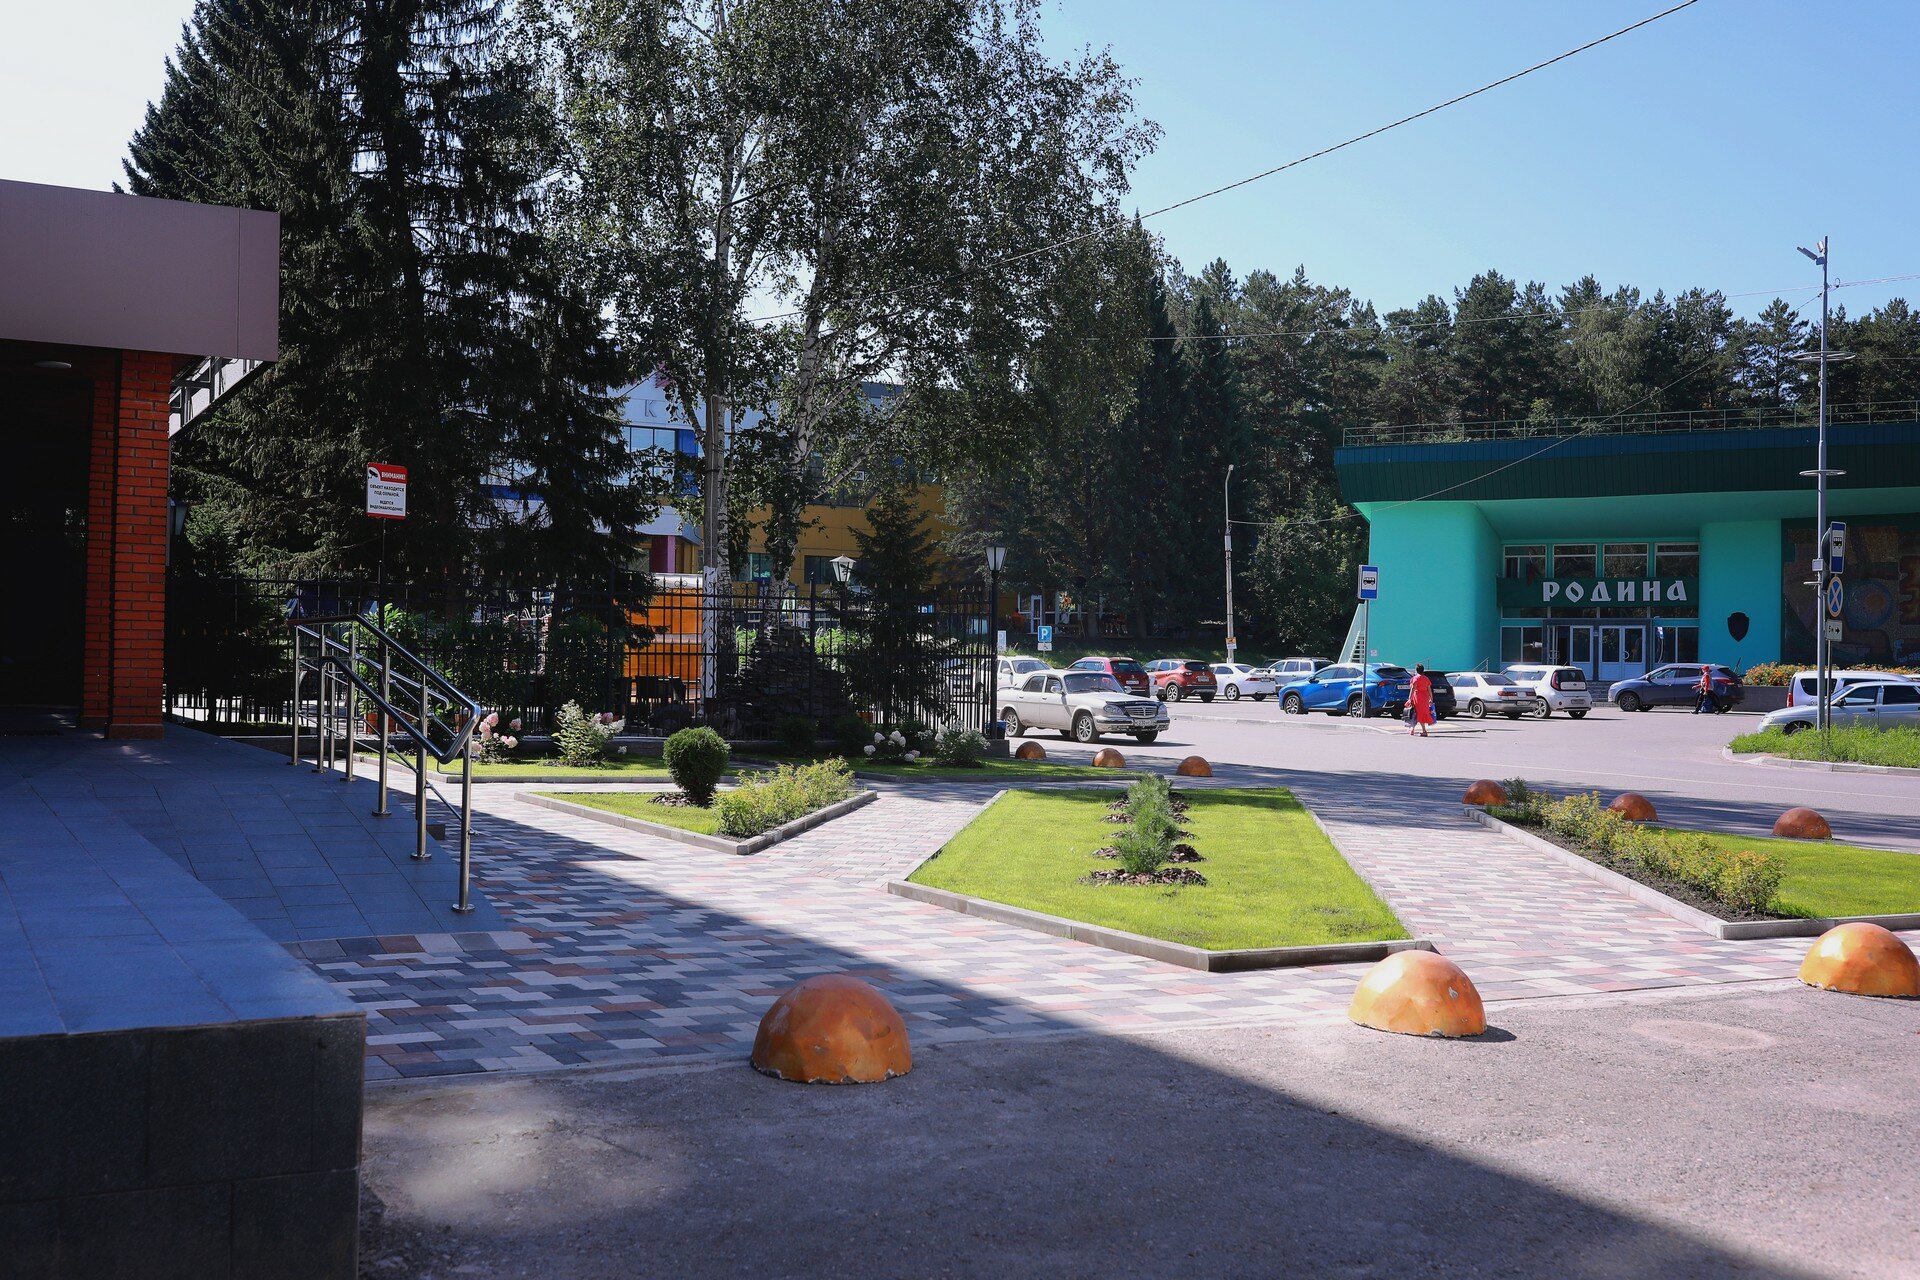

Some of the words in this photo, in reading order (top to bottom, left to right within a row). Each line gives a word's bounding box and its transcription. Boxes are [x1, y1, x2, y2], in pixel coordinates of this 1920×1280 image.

[381, 472, 406, 480] ВНИМАНИЕ!
[1543, 580, 1687, 603] РОДИНА
[1041, 628, 1048, 639] P
